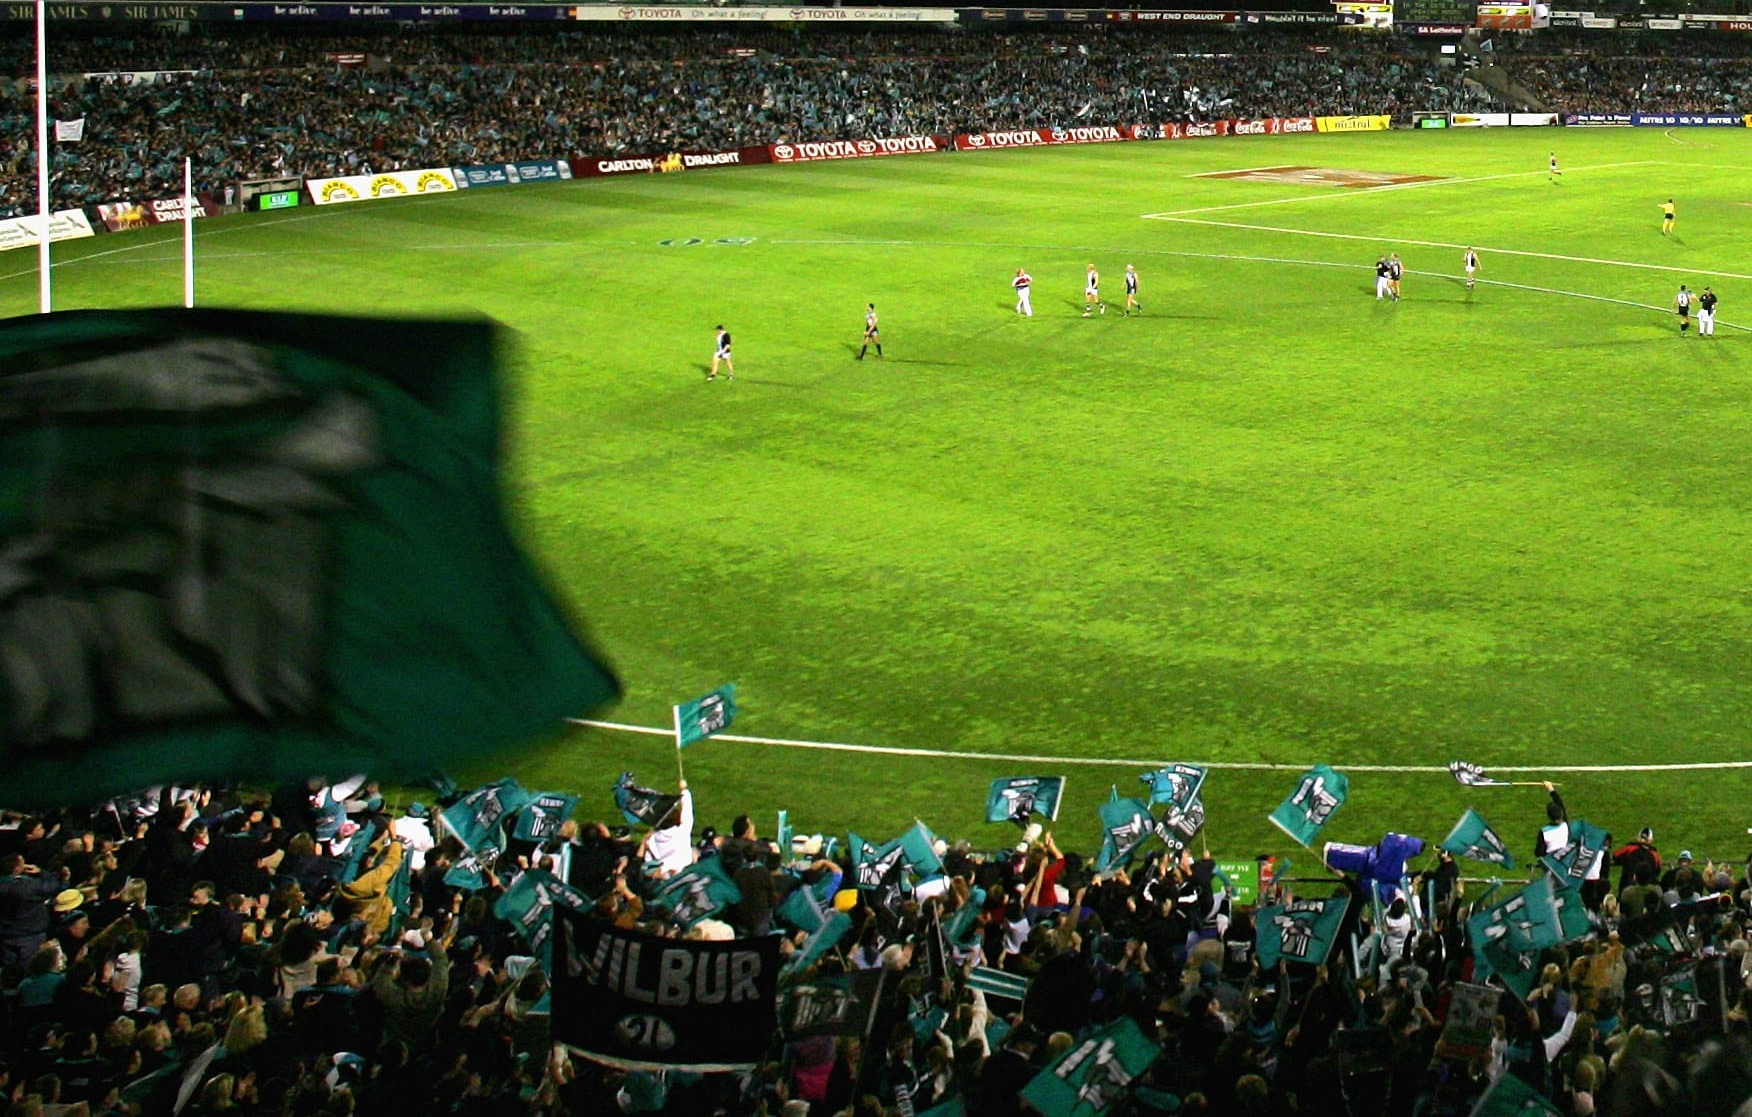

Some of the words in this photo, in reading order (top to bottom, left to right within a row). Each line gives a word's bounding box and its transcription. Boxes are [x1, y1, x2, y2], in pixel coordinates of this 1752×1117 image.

[124, 6, 148, 20] SIR
[152, 6, 198, 21] JAMES
[637, 8, 682, 19] TOYOTA
[806, 9, 847, 20] TOYOTA
[1137, 13, 1161, 21] WEST
[1163, 13, 1181, 21] END
[1183, 13, 1226, 21] DRAUGHT
[1234, 121, 1265, 134] Coca-Cola
[1283, 119, 1314, 132] Coca-Cola
[987, 130, 1042, 146] TOYOTA
[1069, 126, 1121, 141] TOYOTA
[795, 140, 857, 158] TOYOTA
[878, 135, 937, 152] TOYOTA
[598, 157, 653, 174] CARLTON
[683, 151, 740, 167] DRAUGHT
[155, 206, 207, 223] DRAUHT
[562, 916, 762, 1007] WILBUR
